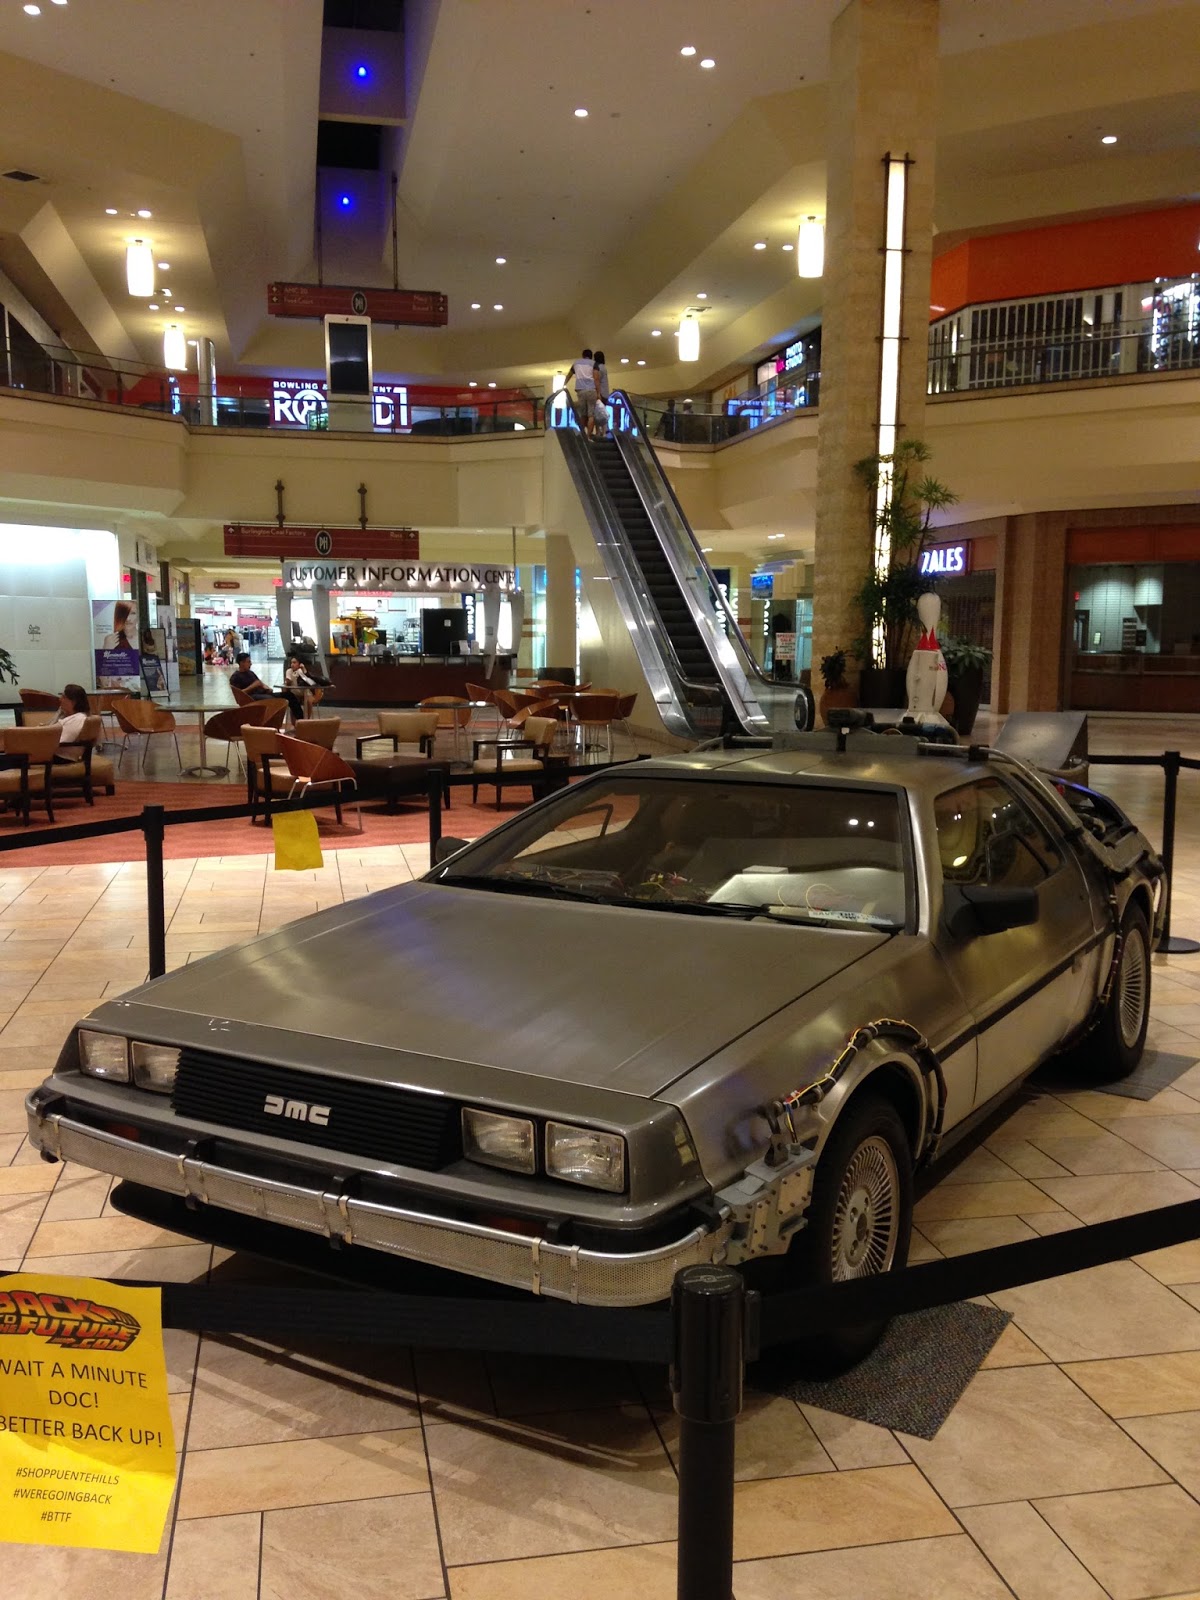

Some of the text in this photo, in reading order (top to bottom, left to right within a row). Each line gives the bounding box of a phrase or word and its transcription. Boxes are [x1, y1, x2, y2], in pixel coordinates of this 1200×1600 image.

[273, 381, 318, 390] BOWLING
[319, 537, 329, 550] PH
[921, 546, 963, 573] ZALES
[289, 566, 356, 581] CUSTOMER
[362, 566, 481, 583] INFORMATION
[18, 1316, 136, 1340] FUTURE
[51, 1362, 65, 1378] A
[71, 1363, 148, 1389] MINUTE
[49, 1390, 99, 1408] DOC!
[0, 1415, 162, 1448] BETTER BACK UP!
[16, 1467, 120, 1486] #SHOPPUENTEHILLS
[13, 1488, 112, 1505] #WEREGOINGBACK
[40, 1511, 72, 1523] #BTTF
